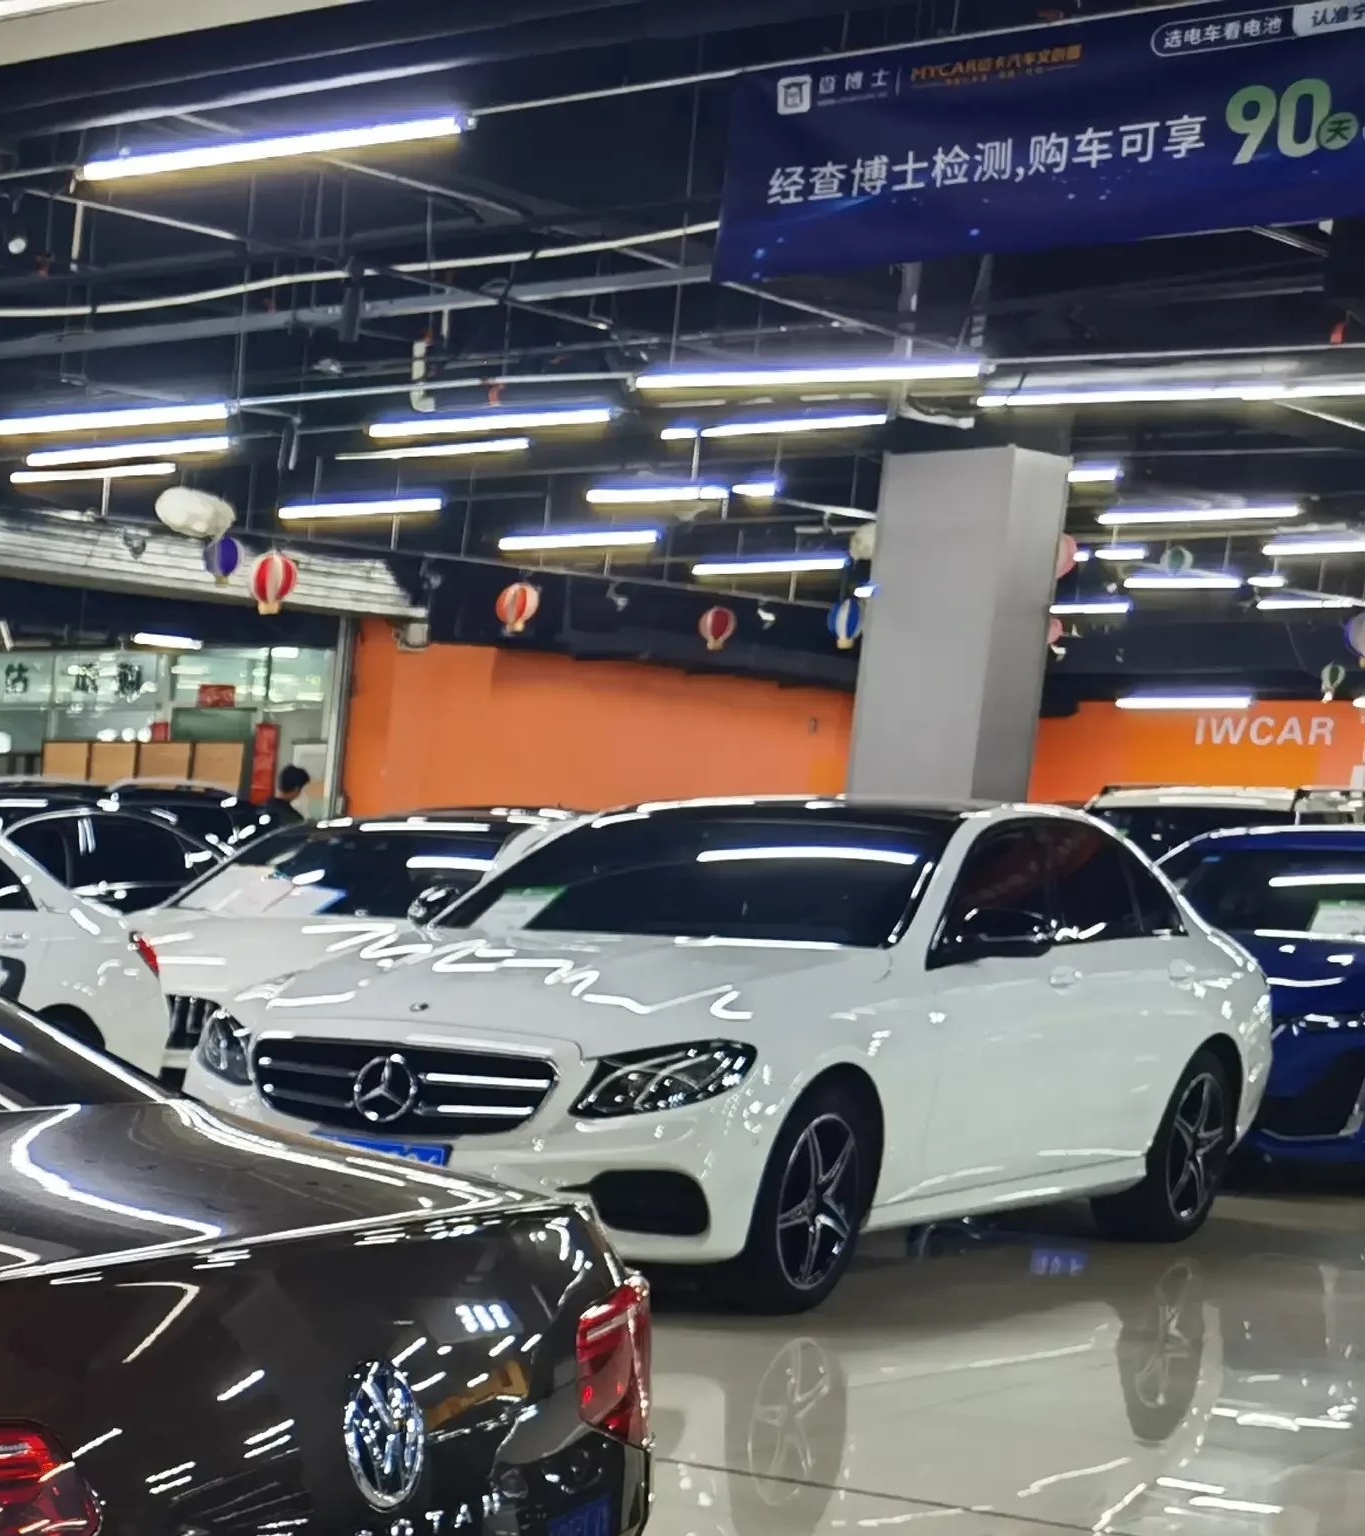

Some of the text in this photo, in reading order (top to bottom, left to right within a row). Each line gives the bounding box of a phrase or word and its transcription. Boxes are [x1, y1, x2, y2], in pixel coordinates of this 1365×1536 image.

[1163, 16, 1283, 49] 选电车看电池
[767, 115, 1207, 204] 经查博士检测,购车可享
[1194, 716, 1335, 746] IWCAR
